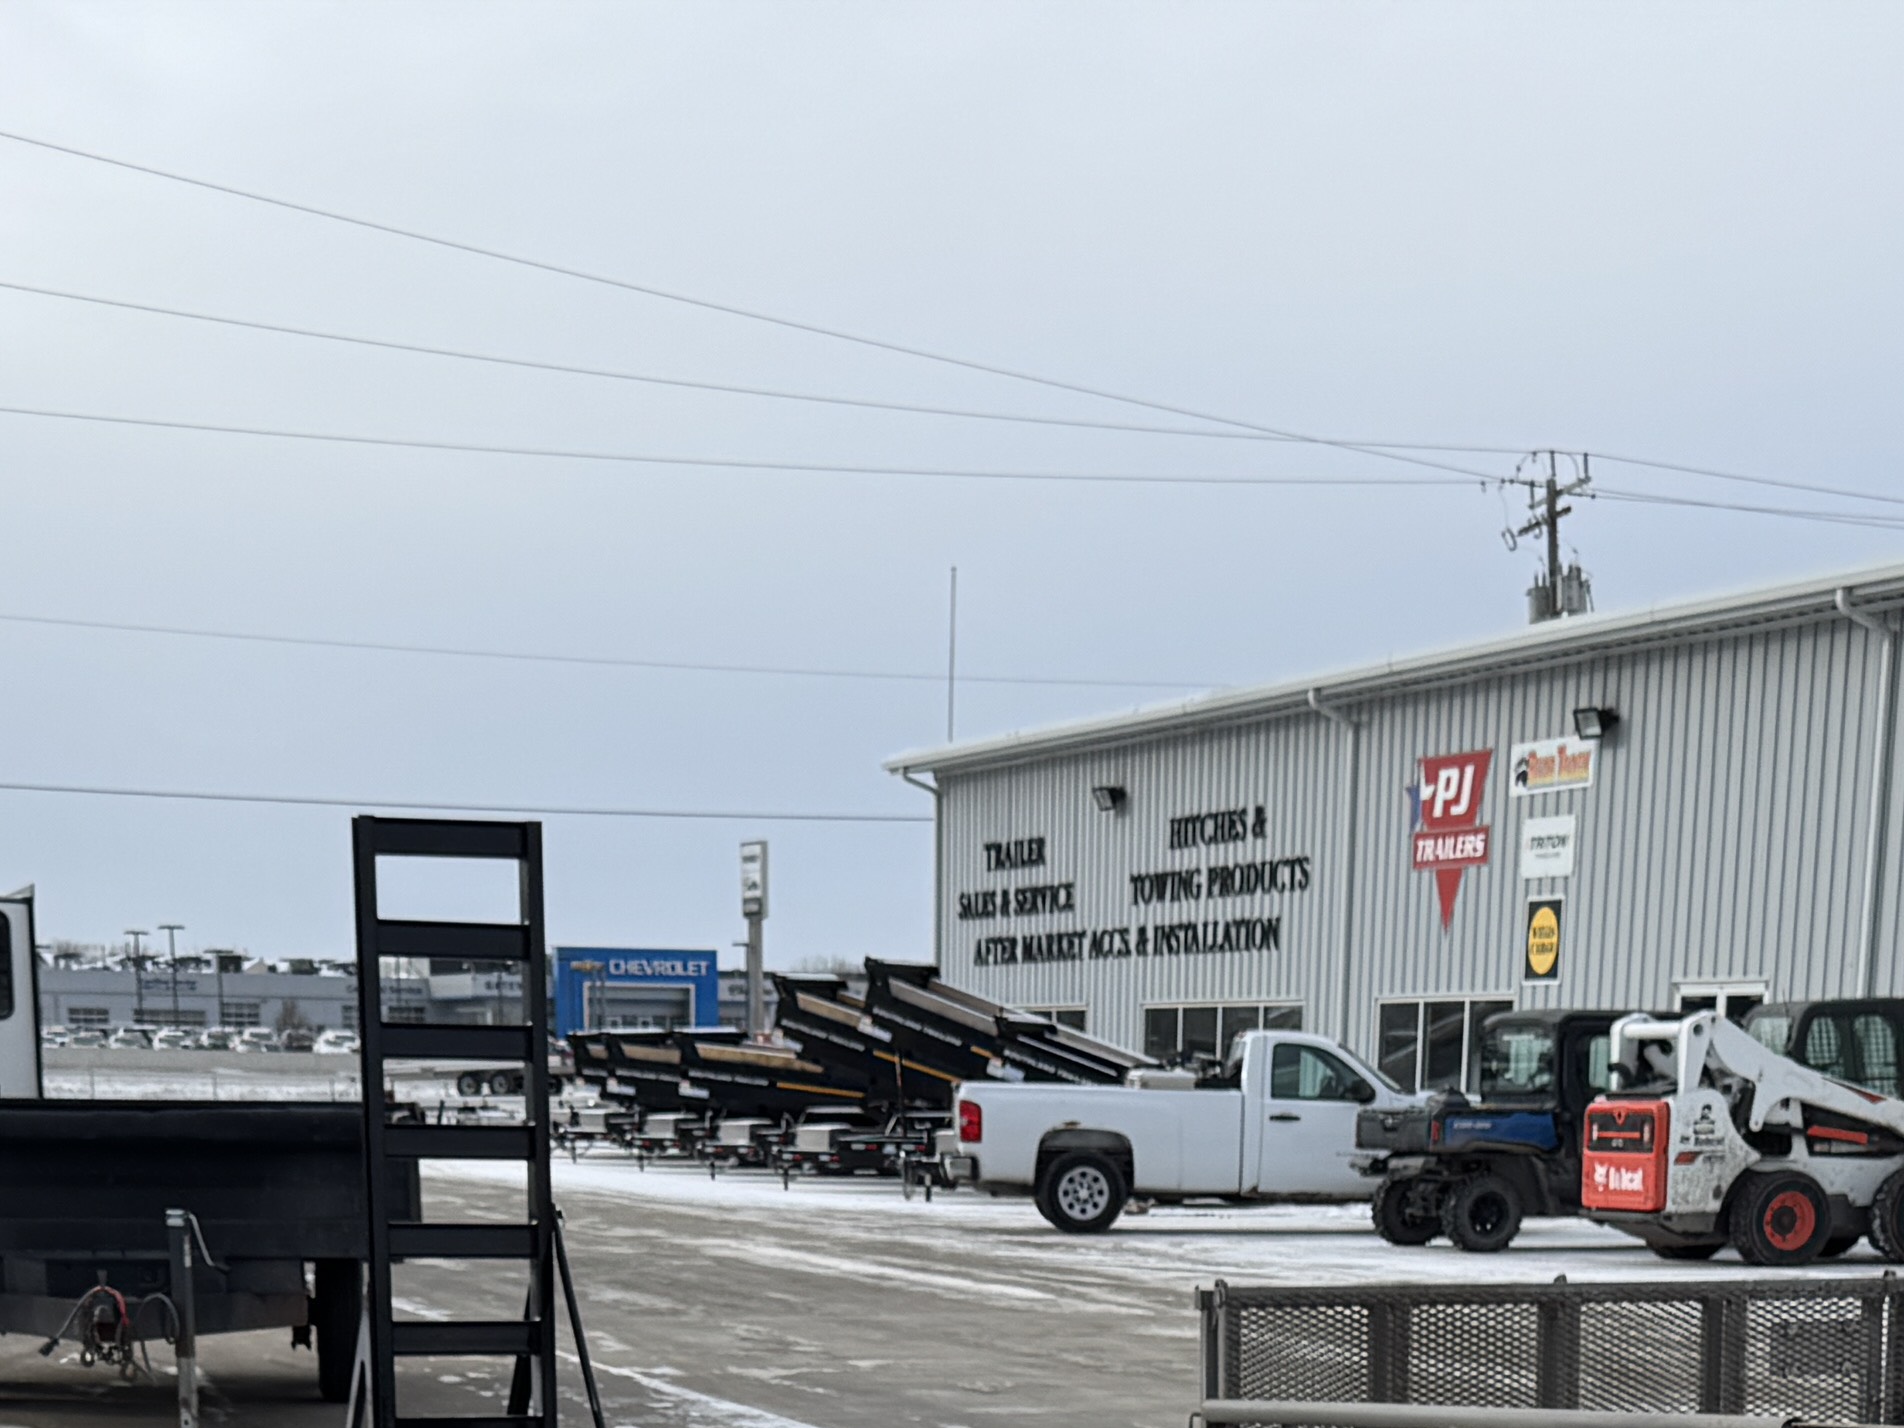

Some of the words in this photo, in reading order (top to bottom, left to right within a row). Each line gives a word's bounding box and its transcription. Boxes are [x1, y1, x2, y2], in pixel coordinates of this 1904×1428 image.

[1432, 765, 1475, 817] PJ
[1169, 808, 1247, 850] HITCHES
[1252, 805, 1267, 839] &
[1416, 834, 1487, 862] TRAILERS
[984, 837, 1045, 872] TRAILER
[958, 891, 996, 921] SALES
[1014, 882, 1075, 915] SERVICE
[1130, 868, 1202, 905] TOWING
[1207, 857, 1310, 898] PRODUCTS
[974, 936, 1018, 967] AFTER
[1021, 930, 1087, 965] MARKET
[1136, 926, 1149, 957] &
[1153, 917, 1282, 957] INSTALLATION
[609, 959, 710, 976] CHEVROLET
